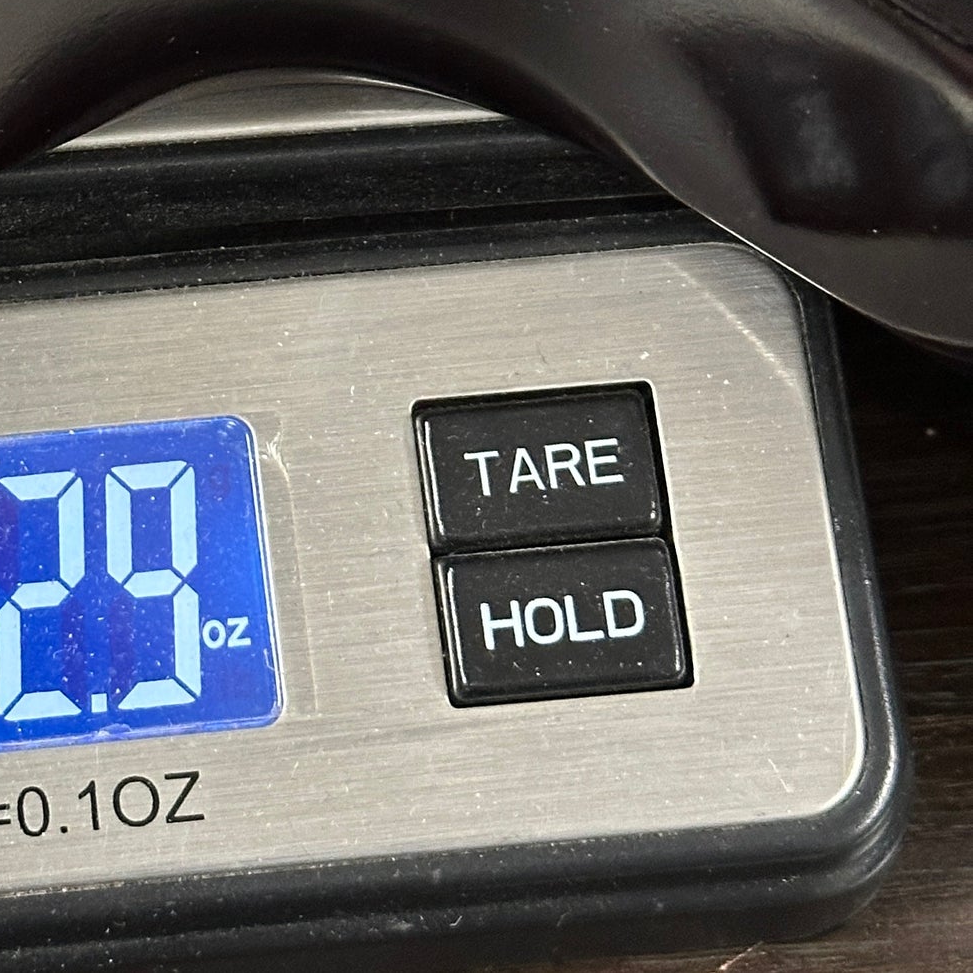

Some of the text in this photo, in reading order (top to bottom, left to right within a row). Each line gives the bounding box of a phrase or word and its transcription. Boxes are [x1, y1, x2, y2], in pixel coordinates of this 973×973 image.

[463, 437, 625, 497] TARE
[202, 616, 252, 650] oz
[479, 589, 645, 651] HOLD
